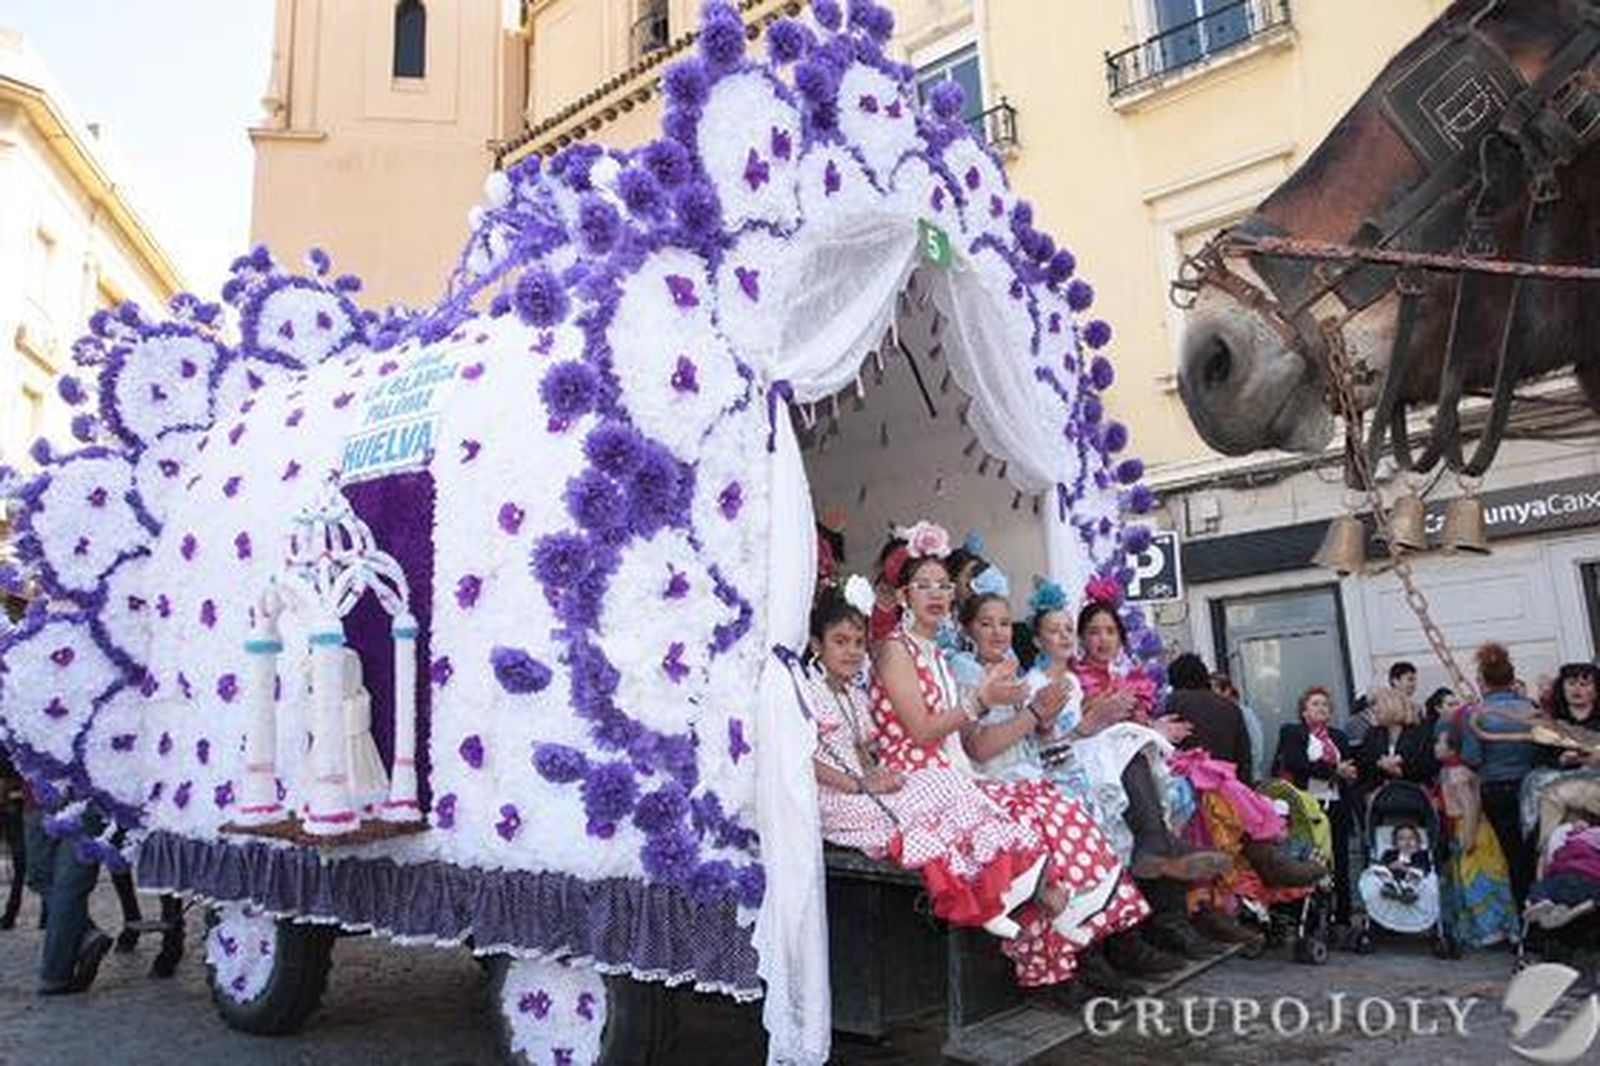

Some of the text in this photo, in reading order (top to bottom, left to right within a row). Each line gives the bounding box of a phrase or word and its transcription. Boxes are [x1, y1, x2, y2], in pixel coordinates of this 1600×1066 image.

[926, 227, 941, 261] 5
[341, 420, 434, 472] HUELVA
[1125, 544, 1165, 597] P
